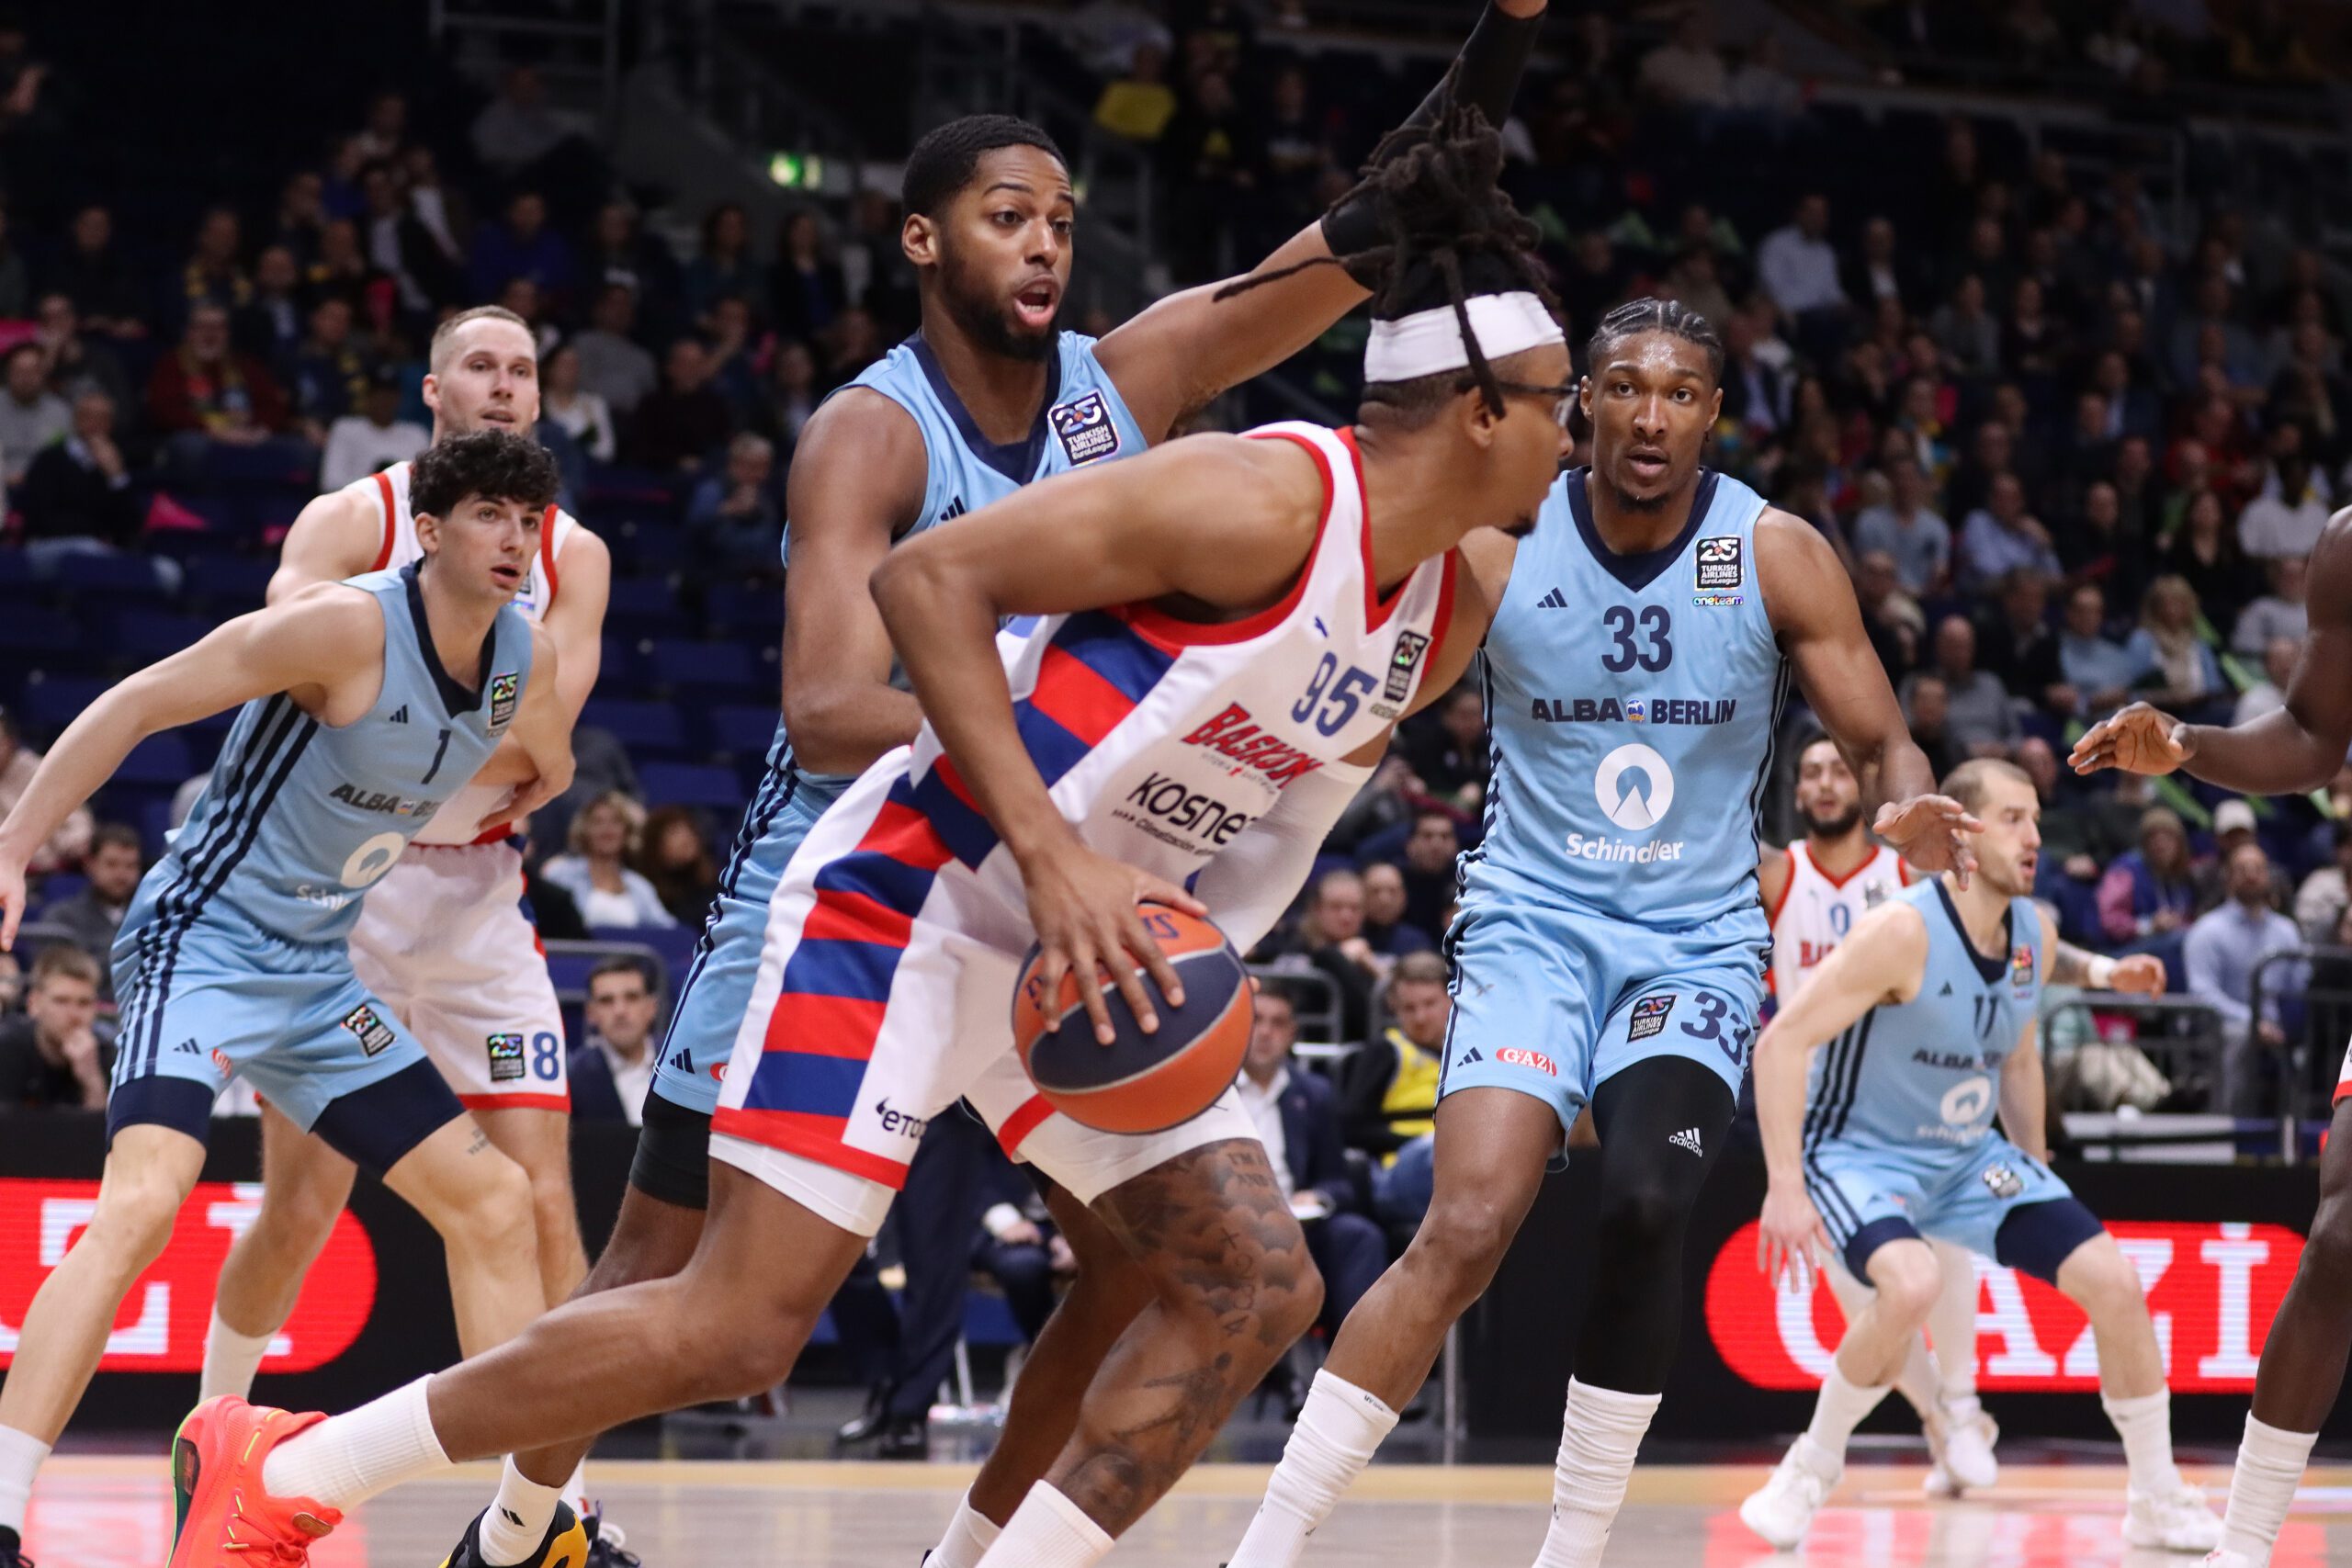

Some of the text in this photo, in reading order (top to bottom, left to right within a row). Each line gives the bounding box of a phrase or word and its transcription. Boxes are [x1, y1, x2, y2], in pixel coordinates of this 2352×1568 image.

[1056, 396, 1102, 434] 25
[1066, 424, 1109, 445] TURKISH
[1070, 433, 1113, 453] AIRLINES
[1700, 538, 1738, 562] 25
[1701, 564, 1738, 572] TURKISH
[1701, 570, 1738, 579] AIRLINES
[1692, 594, 1744, 606] oneteam
[1601, 604, 1673, 673] 33
[1291, 650, 1380, 738] 95
[1531, 697, 1624, 723] ALBA
[1651, 698, 1737, 725] BERLIN
[420, 728, 452, 785] 1
[328, 783, 401, 815] ALBA
[1565, 832, 1684, 864] Schindler
[1634, 998, 1672, 1018] 25
[1632, 1021, 1662, 1032] AIRLINES
[1633, 1016, 1664, 1027] TURKISH
[1680, 991, 1751, 1066] 33
[533, 1032, 560, 1081] 8
[1668, 1134, 1703, 1157] adidas
